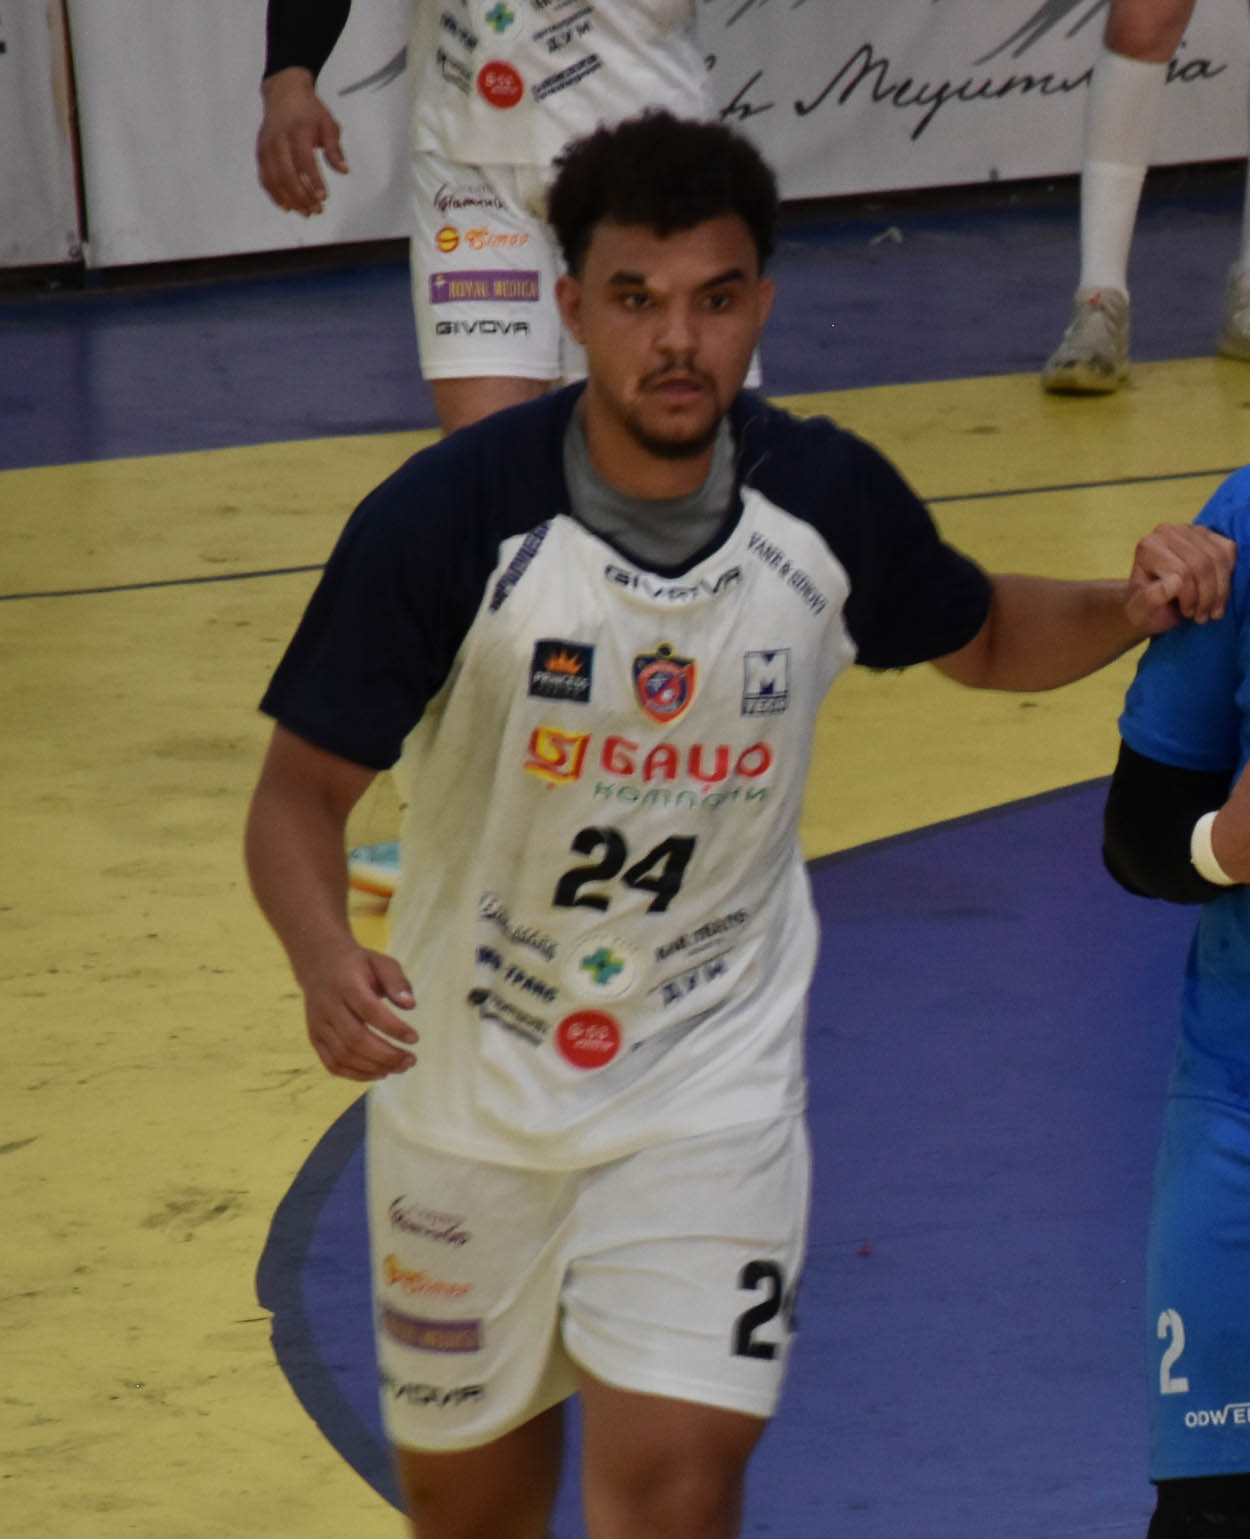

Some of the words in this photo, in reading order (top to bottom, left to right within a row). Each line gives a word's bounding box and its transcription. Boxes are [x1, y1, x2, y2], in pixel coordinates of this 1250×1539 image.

[435, 320, 530, 336] GIVOVA
[552, 825, 699, 914] 24
[1157, 1309, 1189, 1394] 2
[1185, 1408, 1228, 1428] ODW
